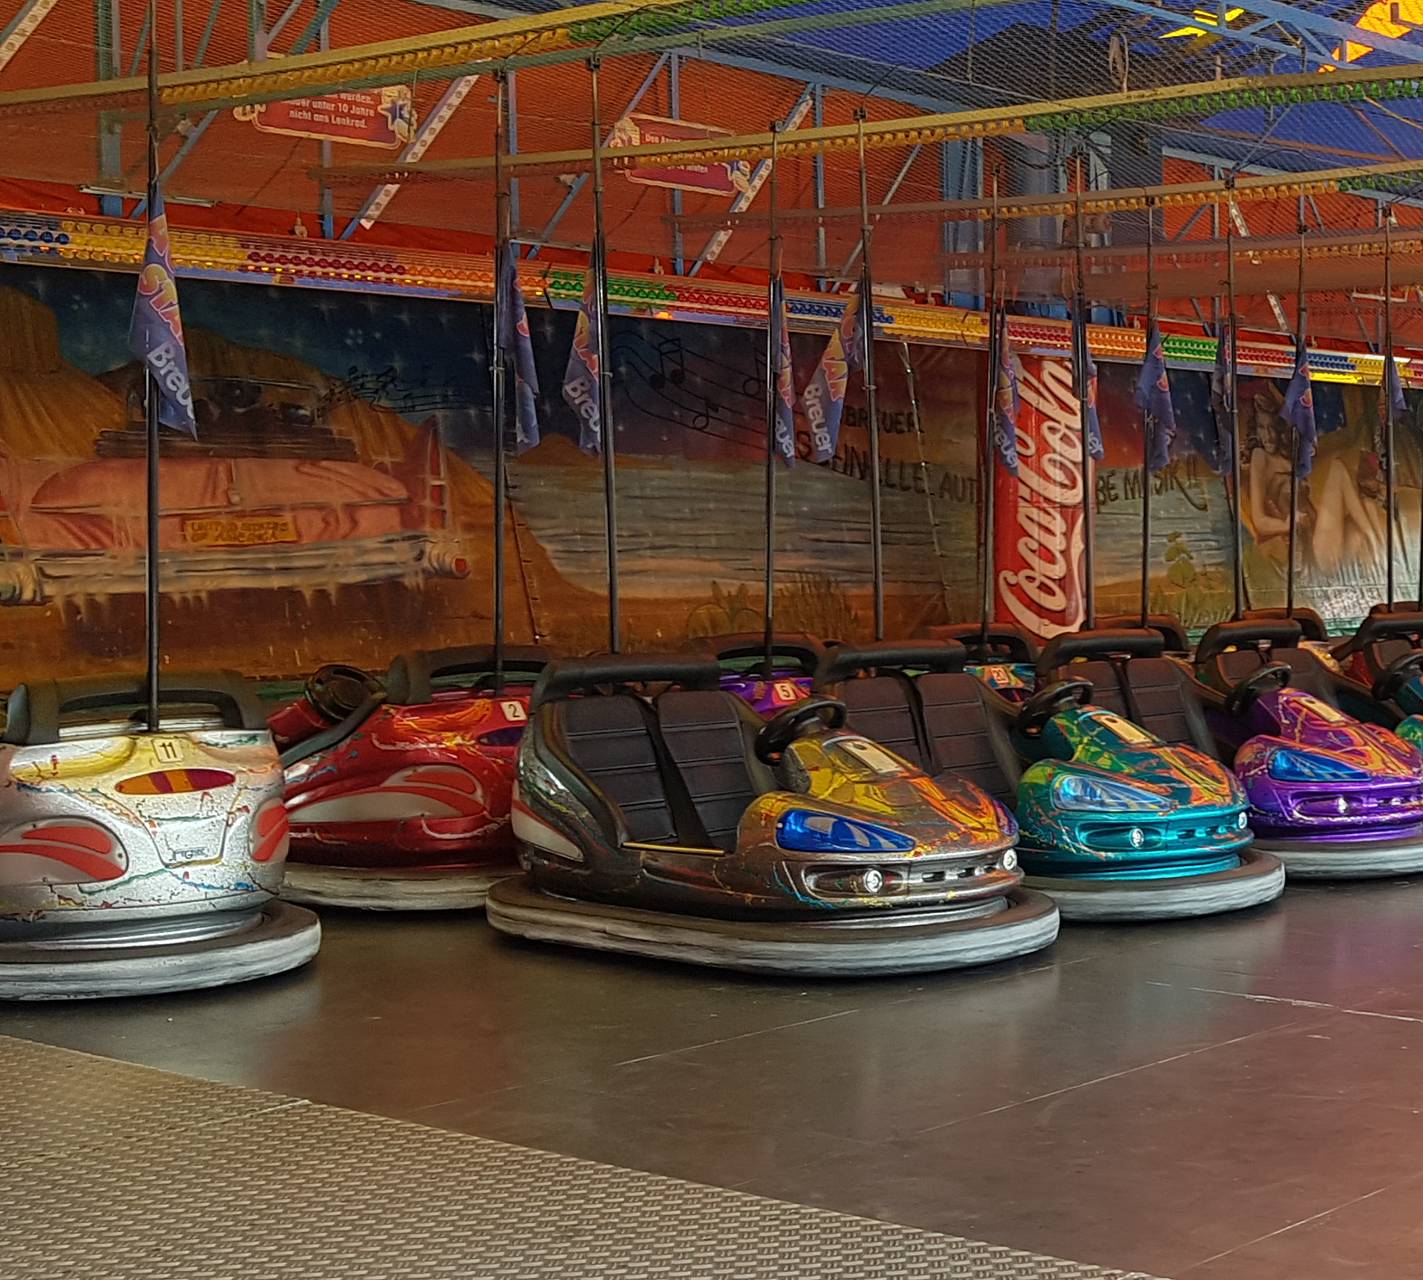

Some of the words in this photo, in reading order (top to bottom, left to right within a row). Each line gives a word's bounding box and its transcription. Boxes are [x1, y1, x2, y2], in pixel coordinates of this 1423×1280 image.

[338, 103, 349, 114] 10
[289, 110, 312, 121] nicht
[780, 686, 791, 699] 5
[508, 704, 520, 719] 2
[160, 741, 175, 759] 11
